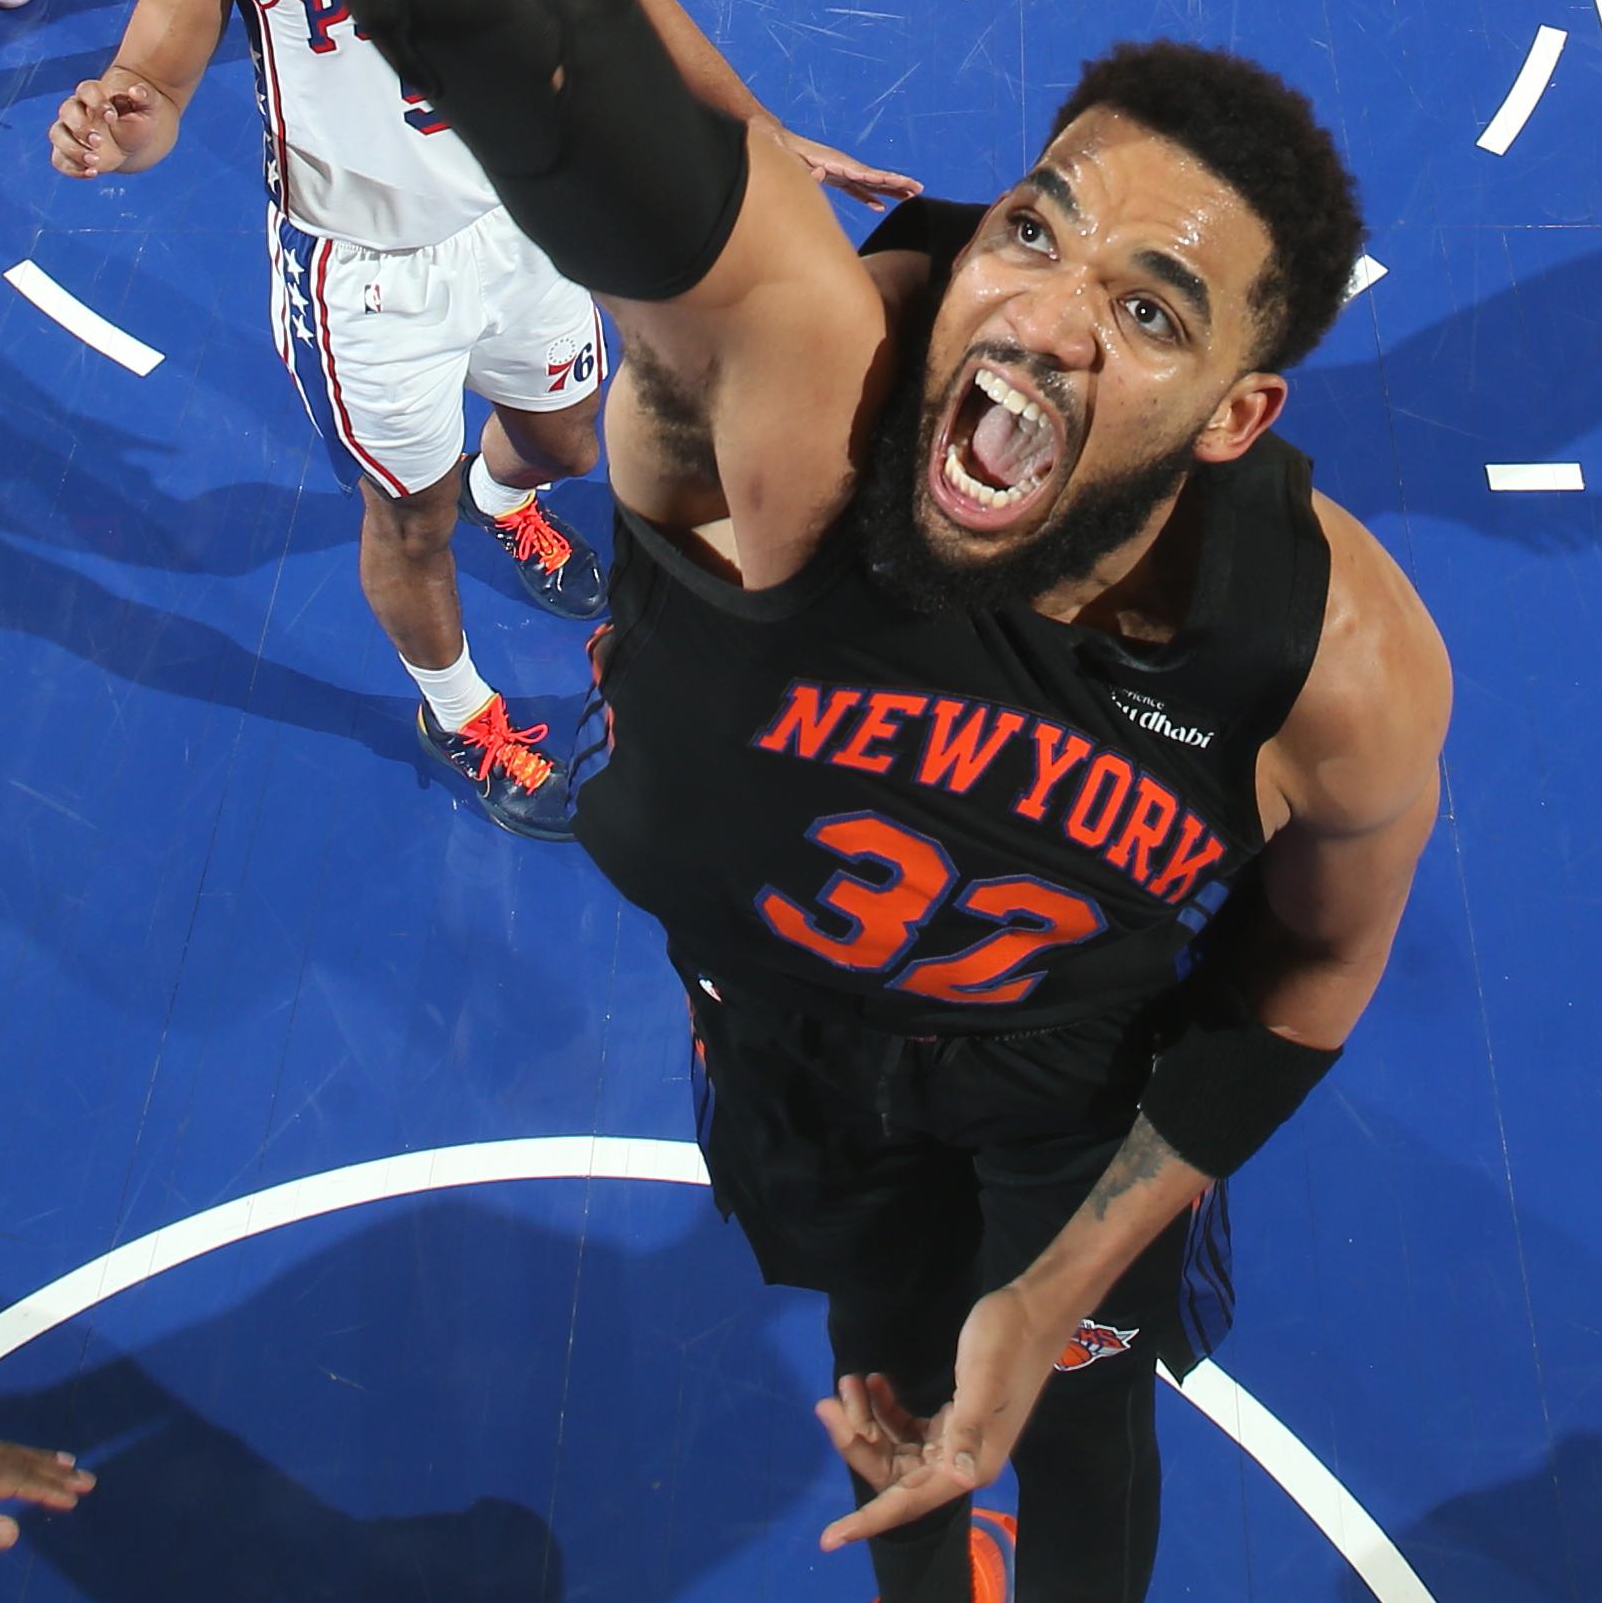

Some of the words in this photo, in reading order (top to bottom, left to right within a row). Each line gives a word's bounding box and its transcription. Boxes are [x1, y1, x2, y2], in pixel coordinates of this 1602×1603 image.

[547, 342, 594, 393] 76
[1139, 711, 1215, 748] dhabi
[749, 678, 1026, 796] NEW
[1013, 720, 1228, 906] YORK
[753, 809, 1108, 1003] 32
